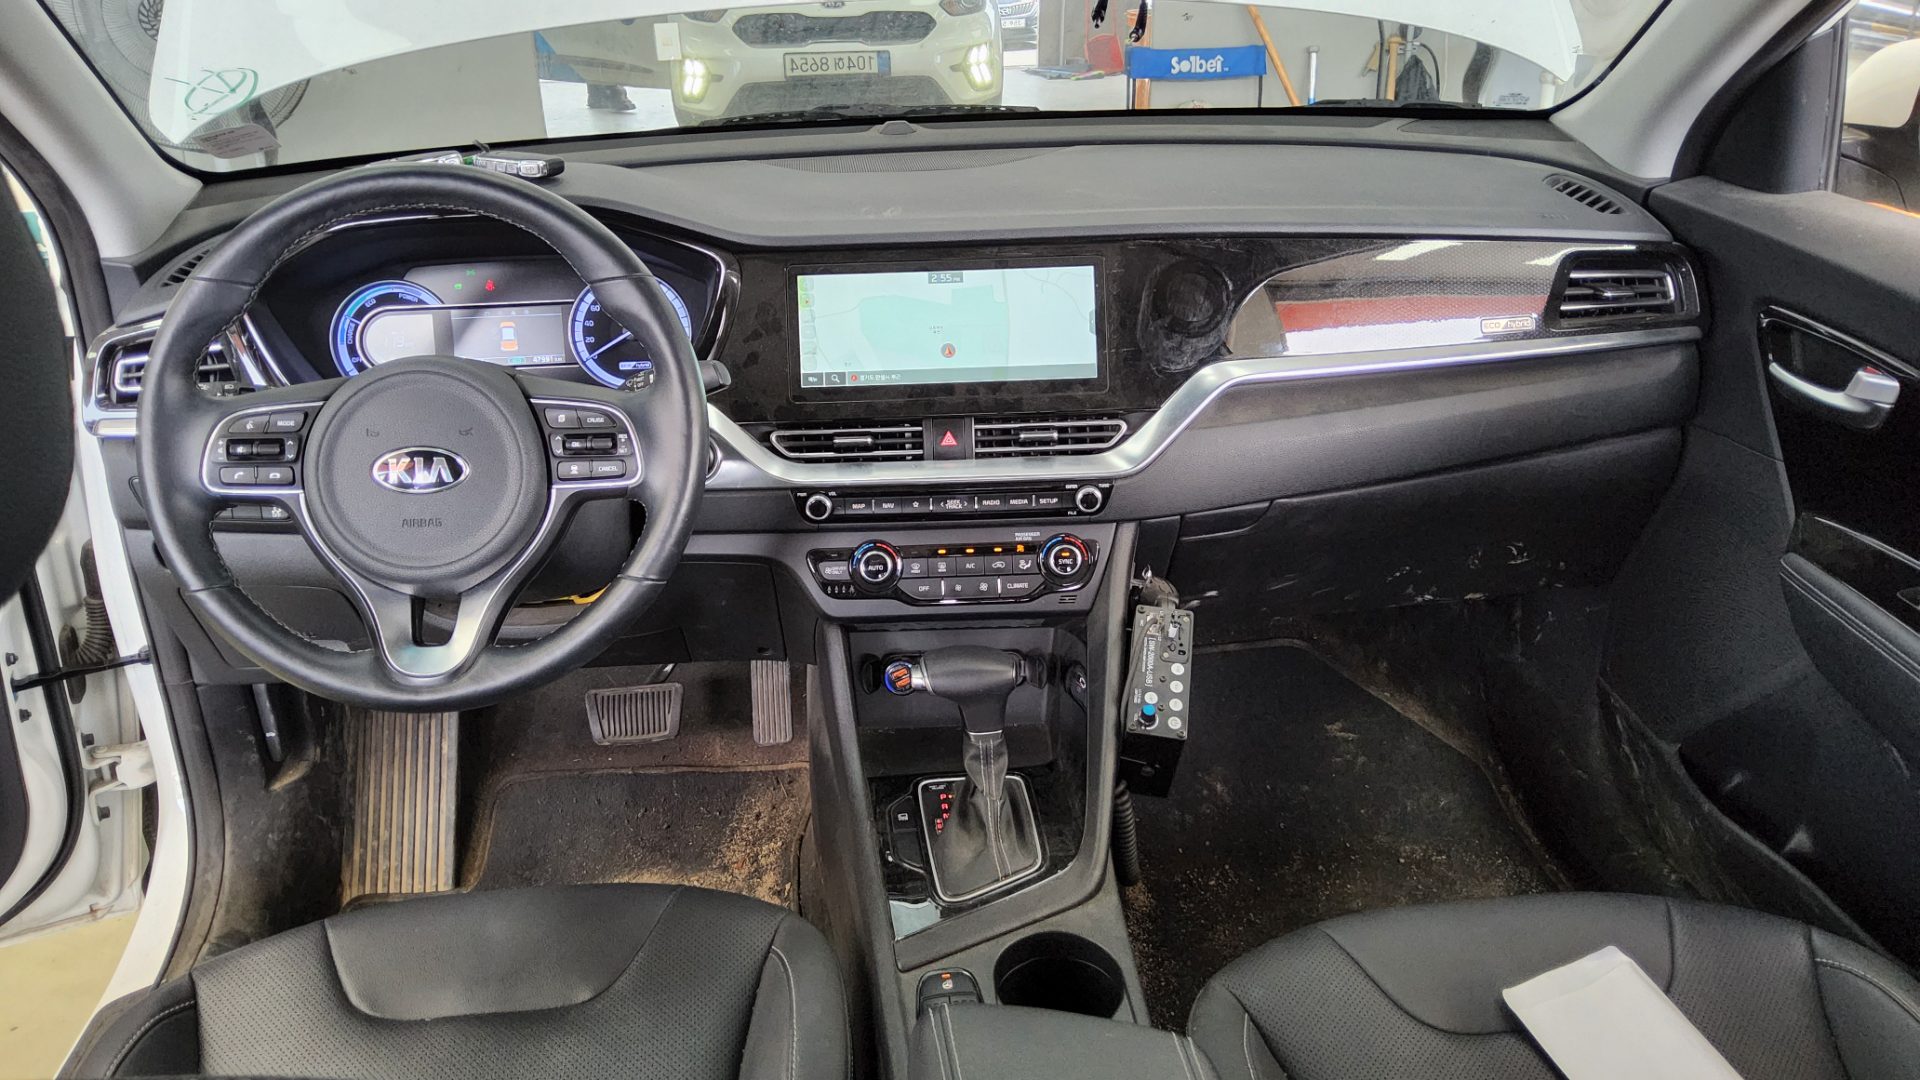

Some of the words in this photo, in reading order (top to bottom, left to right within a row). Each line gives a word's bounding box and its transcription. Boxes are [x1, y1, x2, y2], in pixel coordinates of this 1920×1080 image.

[365, 298, 376, 308] ECO
[387, 457, 454, 484] KIA
[401, 518, 442, 528] AIRBAG
